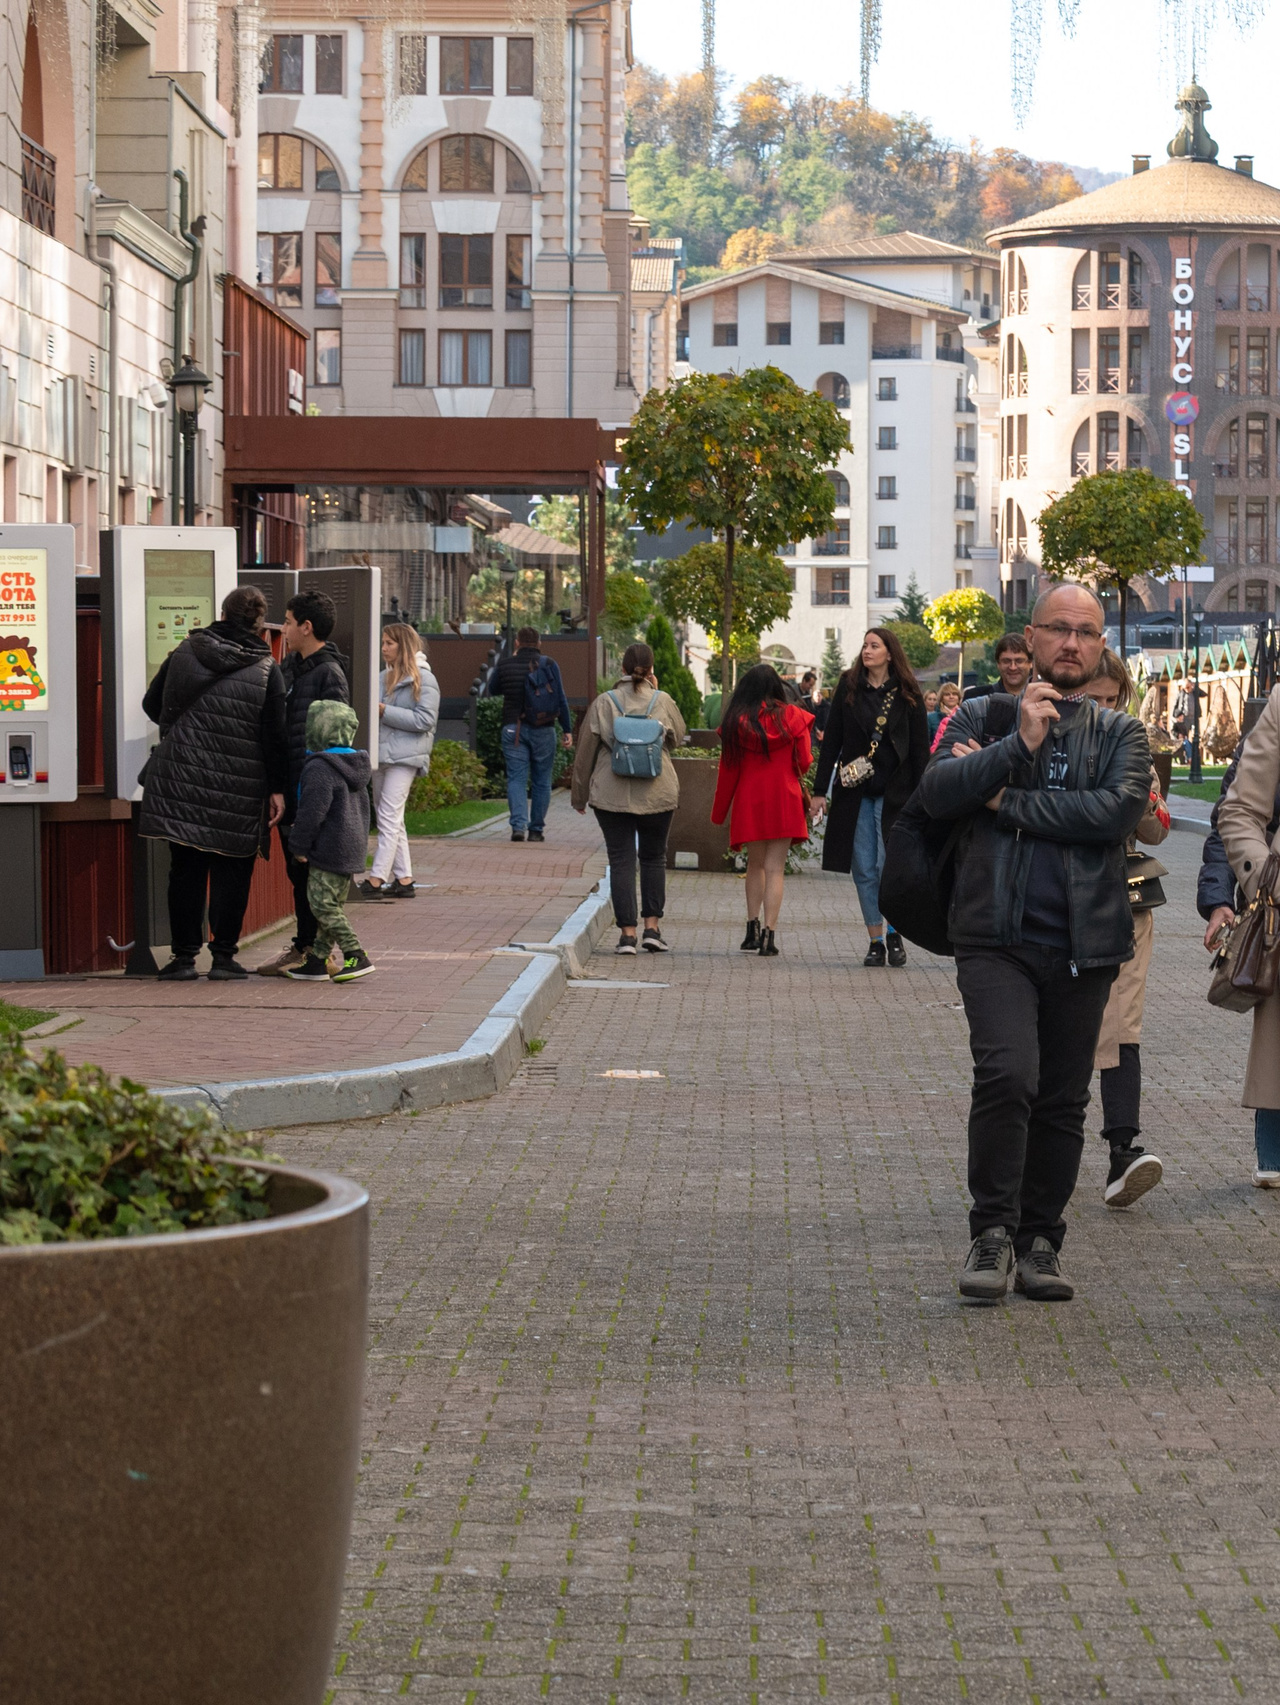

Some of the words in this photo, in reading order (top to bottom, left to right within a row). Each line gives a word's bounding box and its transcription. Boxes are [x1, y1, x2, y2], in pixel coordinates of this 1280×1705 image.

[1172, 258, 1194, 384] БОНУС
[0, 572, 36, 586] СТЬ
[0, 587, 37, 602] ОТА
[13, 614, 25, 622] 99
